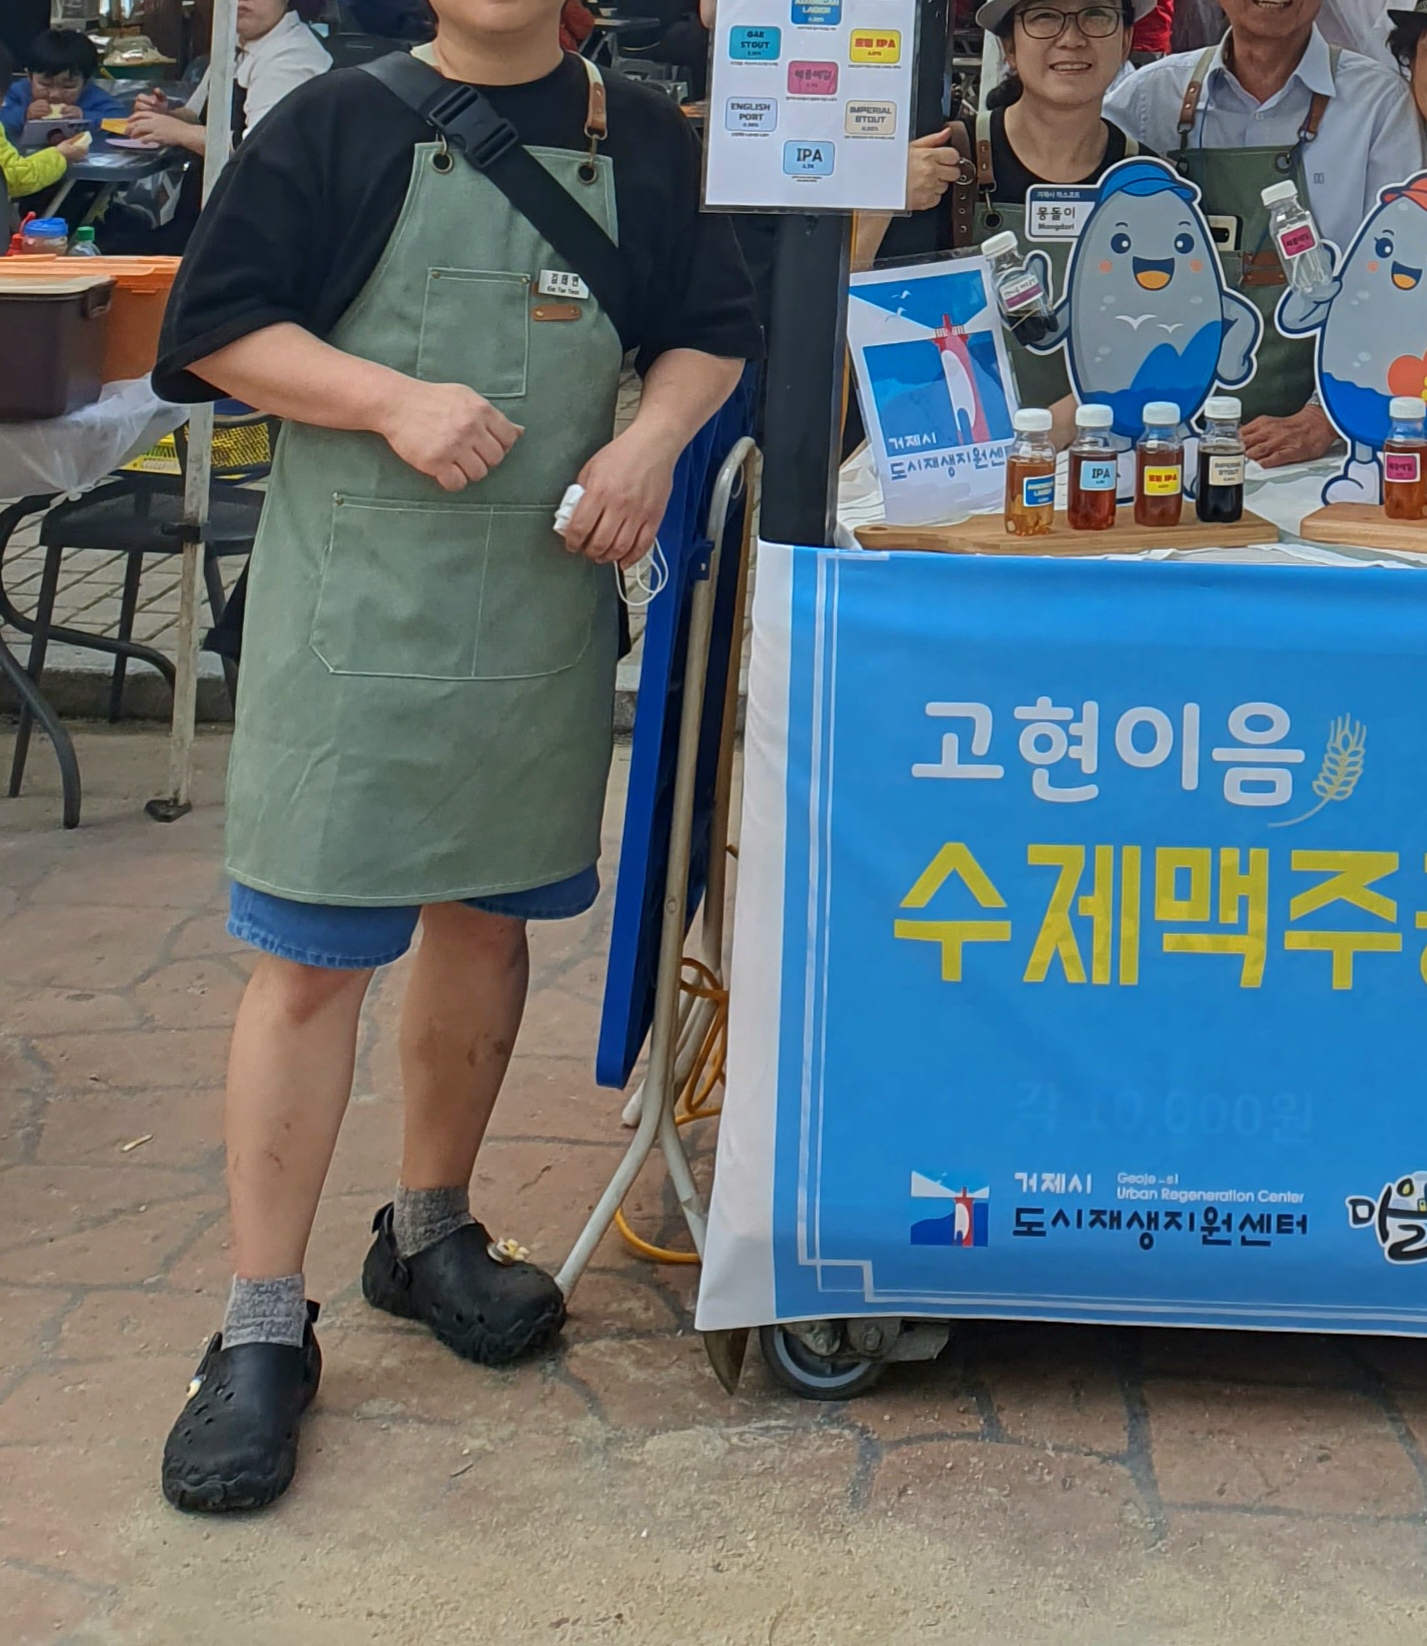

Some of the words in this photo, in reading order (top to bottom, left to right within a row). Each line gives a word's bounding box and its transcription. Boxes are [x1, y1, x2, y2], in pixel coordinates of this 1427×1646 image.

[730, 102, 771, 112] ENGLISH
[849, 105, 893, 115] IMPERIAL
[738, 112, 765, 122] PORT
[796, 147, 823, 163] IPA
[888, 432, 937, 450] 거제시
[1092, 467, 1111, 479] IPA
[911, 696, 1306, 806] 고현이음
[1014, 1172, 1093, 1195] 거제시
[1117, 1187, 1158, 1201] Urban
[1161, 1188, 1255, 1205] Regeneration
[1257, 1189, 1305, 1204] Center
[1012, 1206, 1309, 1251] 도시재생지원센터
